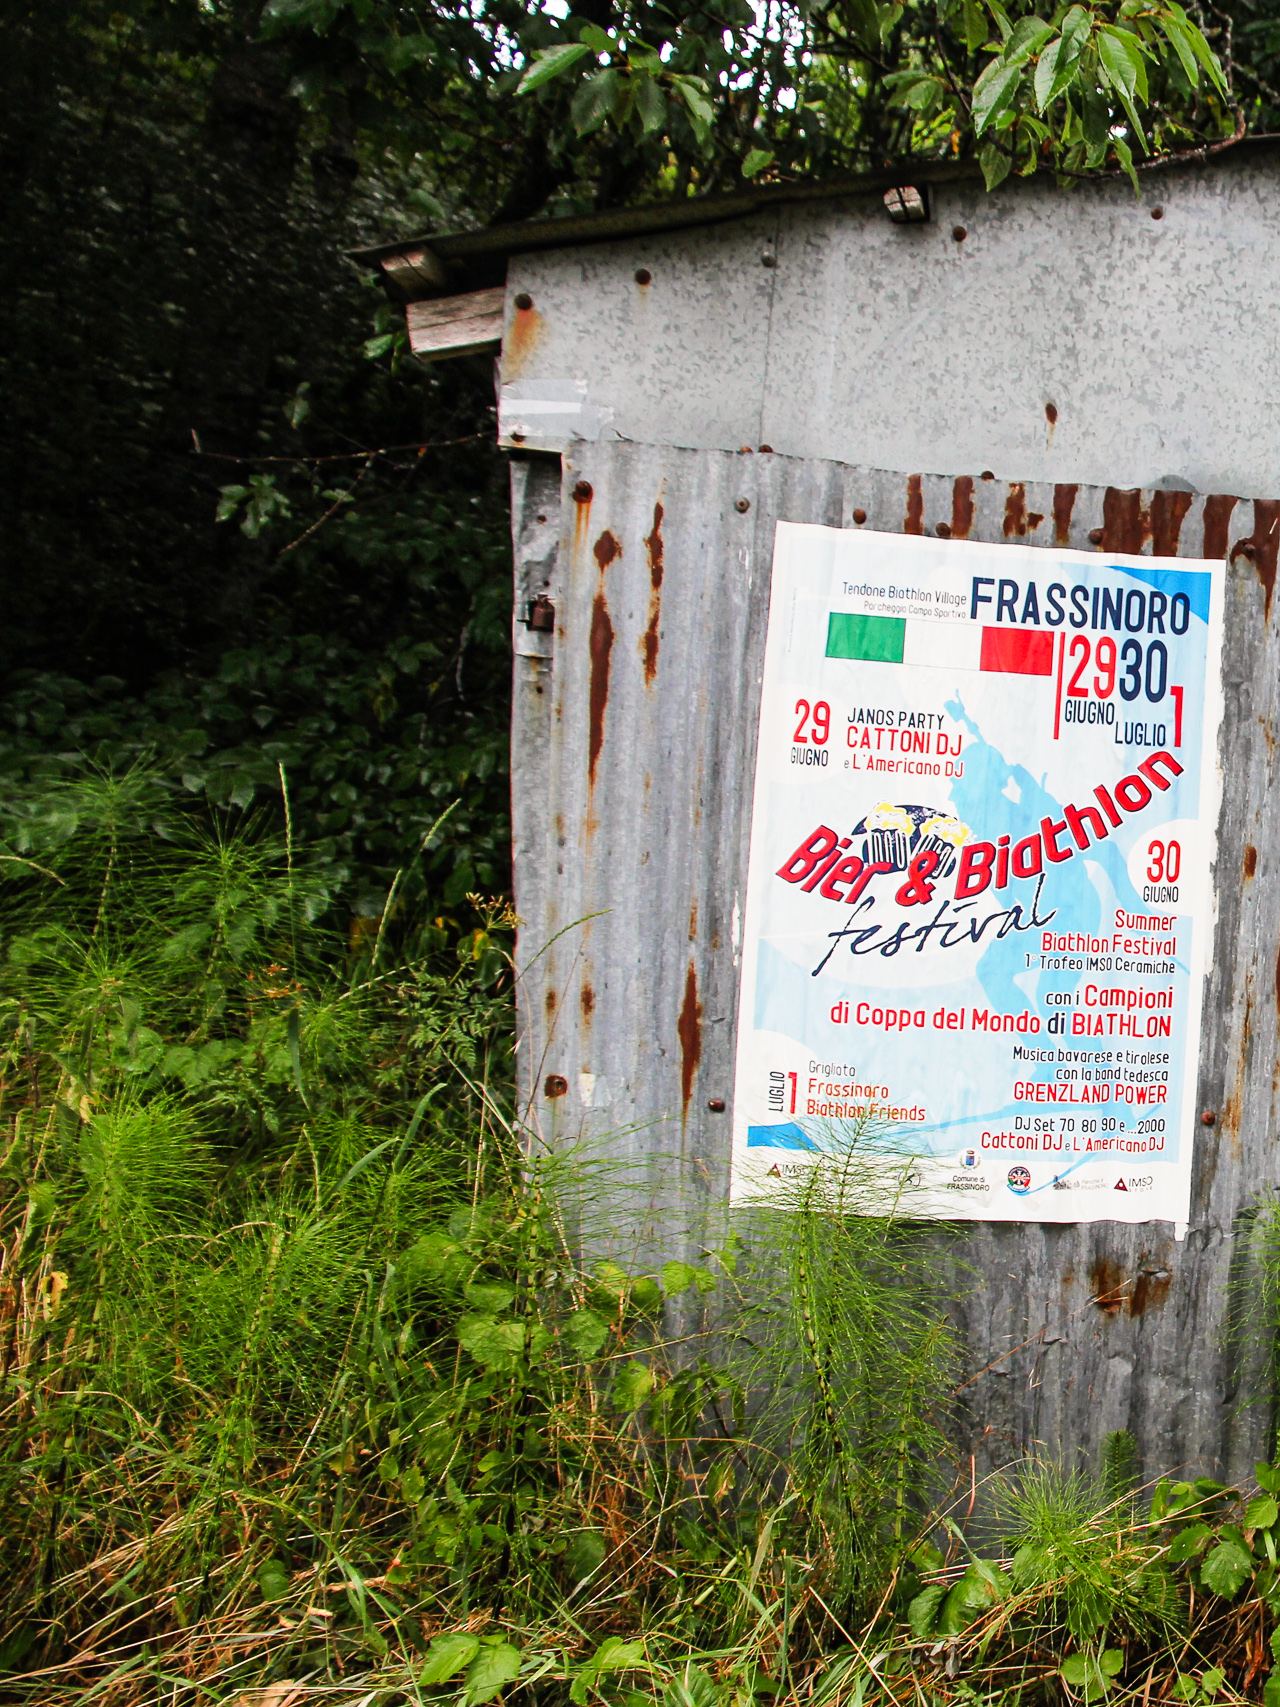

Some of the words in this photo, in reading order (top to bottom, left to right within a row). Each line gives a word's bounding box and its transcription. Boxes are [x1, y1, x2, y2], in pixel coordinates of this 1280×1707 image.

[843, 581, 885, 598] Tendone
[888, 585, 932, 602] Biathlon
[935, 590, 967, 607] Village
[864, 600, 906, 614] Parcheggio
[908, 605, 933, 616] Campo
[934, 607, 966, 619] Sportivo
[970, 576, 1190, 636] FRASSINORO
[793, 698, 831, 745] 29
[847, 707, 894, 726] JANOS
[898, 711, 945, 730] PARTY
[1065, 699, 1115, 725] GIUGNO
[1115, 721, 1166, 747] LUGLIO
[1170, 685, 1184, 747] 1
[846, 725, 931, 754] CATTONI
[936, 732, 963, 756] DJ
[790, 747, 829, 767] GIUGNO
[844, 759, 850, 769] e
[853, 753, 941, 776] L'Americano
[945, 761, 964, 778] DJ
[775, 824, 893, 904] Bier
[895, 848, 939, 906] &
[954, 750, 1185, 900] Biathlon
[1146, 840, 1182, 883] 30
[1143, 885, 1179, 903] GIUGNO
[811, 873, 1057, 977] festival
[1115, 909, 1177, 931] Summer
[1042, 932, 1109, 953] Biathlon
[1112, 934, 1176, 956] Festival
[1040, 955, 1083, 970] Trofeo
[1086, 957, 1112, 972] IMSO
[1115, 957, 1175, 974] Ceramiche
[1046, 992, 1071, 1006] con
[1076, 990, 1080, 1006] i
[1084, 984, 1173, 1011] Campioni
[830, 1001, 849, 1024] di
[856, 1002, 925, 1031] Coppa
[932, 1007, 965, 1030] del
[971, 1009, 1041, 1034] Mondo
[1047, 1012, 1066, 1035] di
[1072, 1012, 1172, 1038] BIATHLON
[1013, 1046, 1054, 1062] Musica
[1058, 1049, 1113, 1064] bavarese
[1116, 1051, 1123, 1063] e
[1125, 1050, 1169, 1065] tirolese
[809, 1060, 856, 1077] Grigliata
[1056, 1068, 1078, 1081] con
[1081, 1067, 1092, 1081] la
[1095, 1066, 1121, 1081] band
[1123, 1067, 1168, 1083] tedesca
[768, 1071, 785, 1112] LUGLIO
[788, 1072, 798, 1115] 1
[808, 1078, 889, 1099] Frassinoro
[1014, 1081, 1110, 1103] GRENZLAND
[1115, 1083, 1167, 1104] POWER
[807, 1099, 865, 1119] Biathlon
[869, 1103, 926, 1122] Friends
[1014, 1116, 1031, 1131] DJ
[1034, 1117, 1055, 1132] Set
[1059, 1118, 1075, 1132] 70
[1081, 1119, 1097, 1133] 80
[1101, 1117, 1116, 1131] 90
[1119, 1120, 1125, 1131] e
[981, 1132, 1038, 1150] Cattoni
[1042, 1134, 1063, 1151] DJ
[1065, 1142, 1071, 1151] e
[1073, 1136, 1147, 1153] L'Americano
[1149, 1136, 1165, 1151] DJ
[946, 1182, 990, 1191] FRASSINORO
[953, 1175, 978, 1183] Comune
